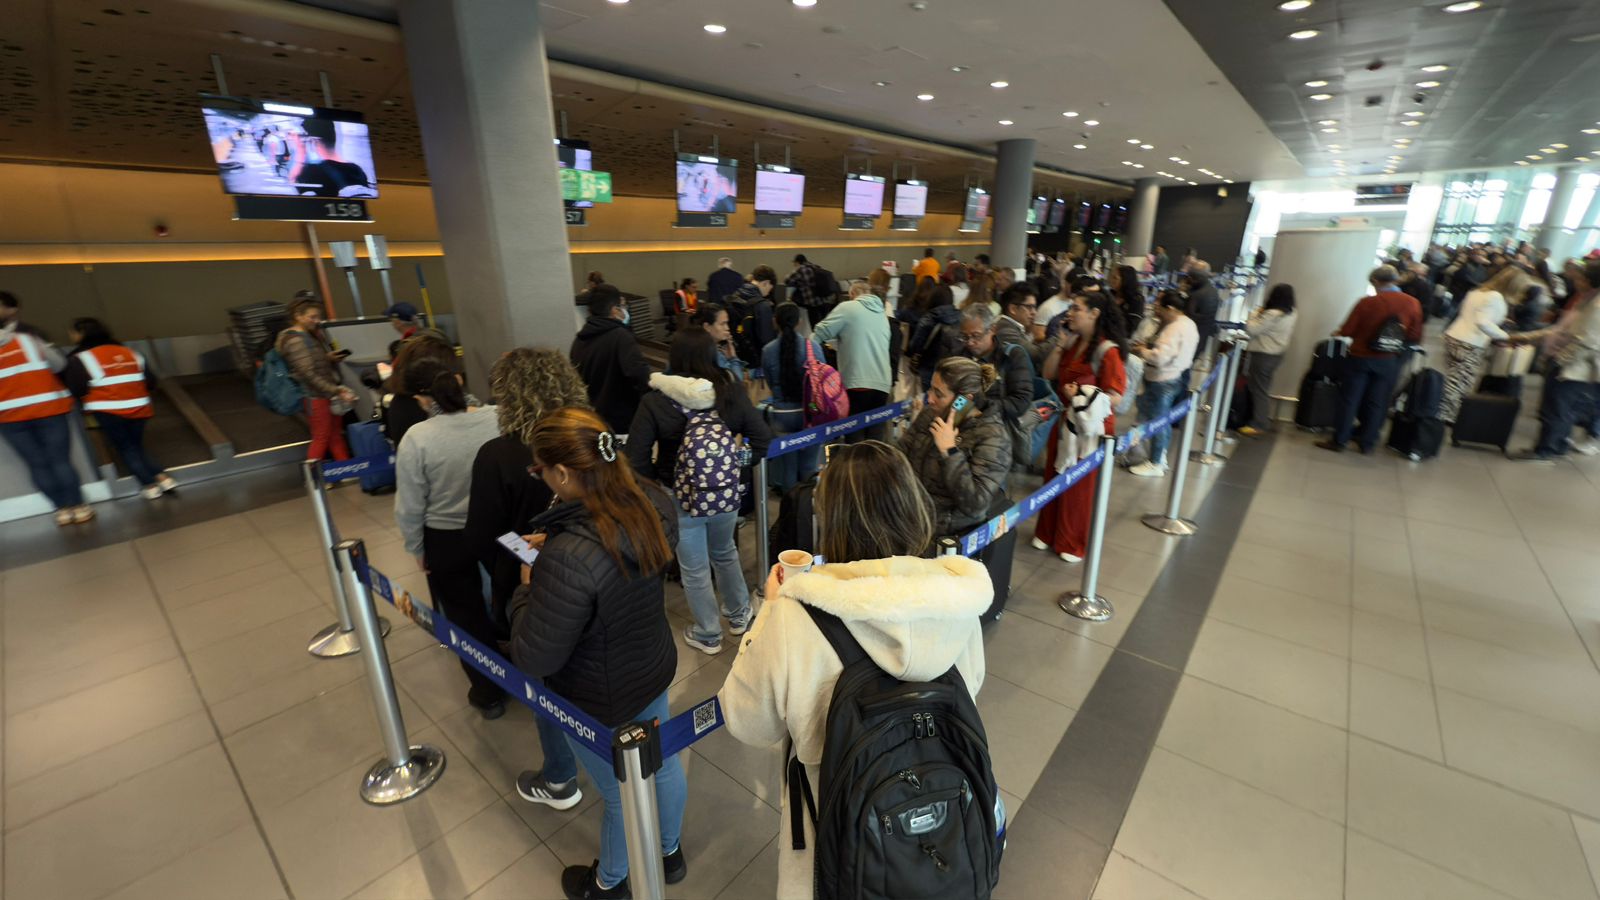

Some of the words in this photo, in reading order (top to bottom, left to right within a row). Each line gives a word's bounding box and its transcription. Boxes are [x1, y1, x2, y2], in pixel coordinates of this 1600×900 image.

[324, 202, 363, 217] 158
[566, 211, 581, 222] 57
[323, 461, 370, 477] espegar
[461, 640, 506, 679] despegar
[539, 695, 596, 742] despegar
